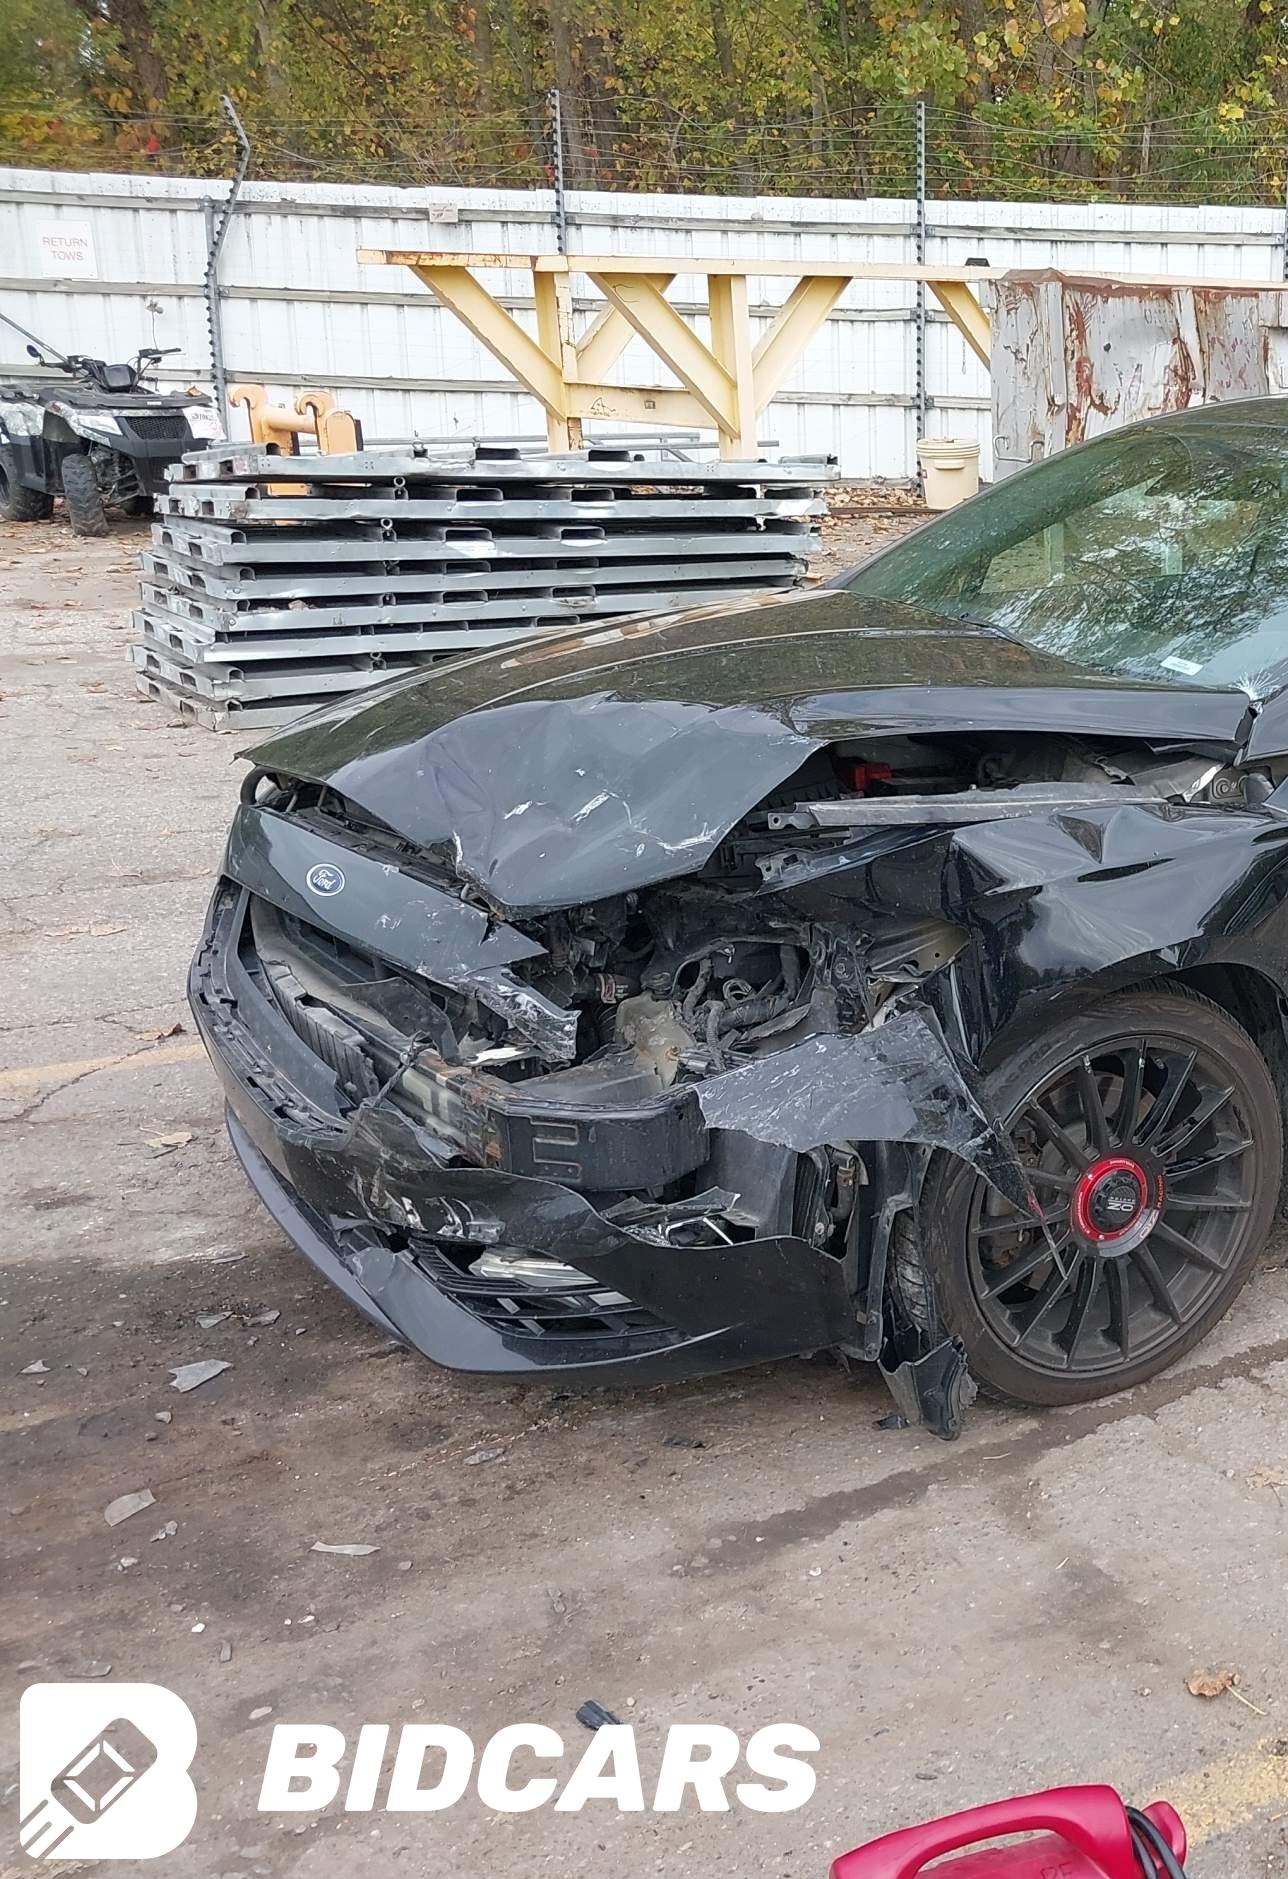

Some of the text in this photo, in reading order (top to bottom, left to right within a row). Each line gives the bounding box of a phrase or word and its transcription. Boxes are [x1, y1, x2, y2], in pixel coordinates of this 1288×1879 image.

[42, 237, 88, 247] RETURN
[52, 250, 84, 260] TOWS
[312, 869, 336, 890] Ford
